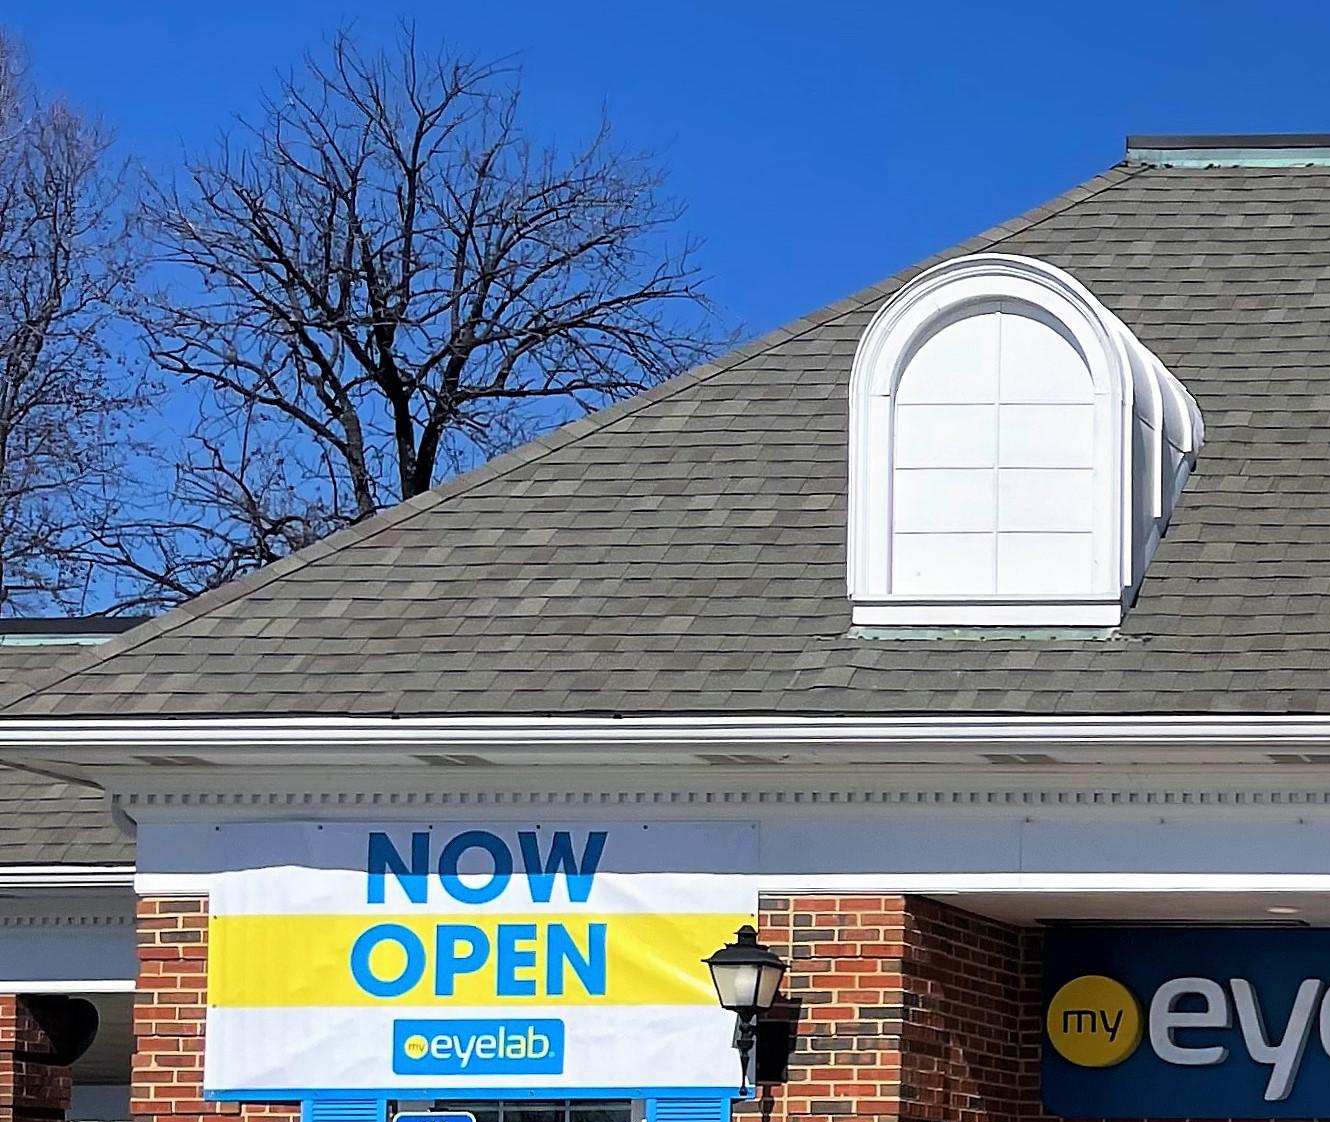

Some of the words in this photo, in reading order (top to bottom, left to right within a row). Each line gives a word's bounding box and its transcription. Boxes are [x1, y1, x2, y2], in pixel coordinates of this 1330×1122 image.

[367, 830, 608, 904] NOW
[351, 923, 607, 997] OPEN
[1062, 1009, 1123, 1042] my
